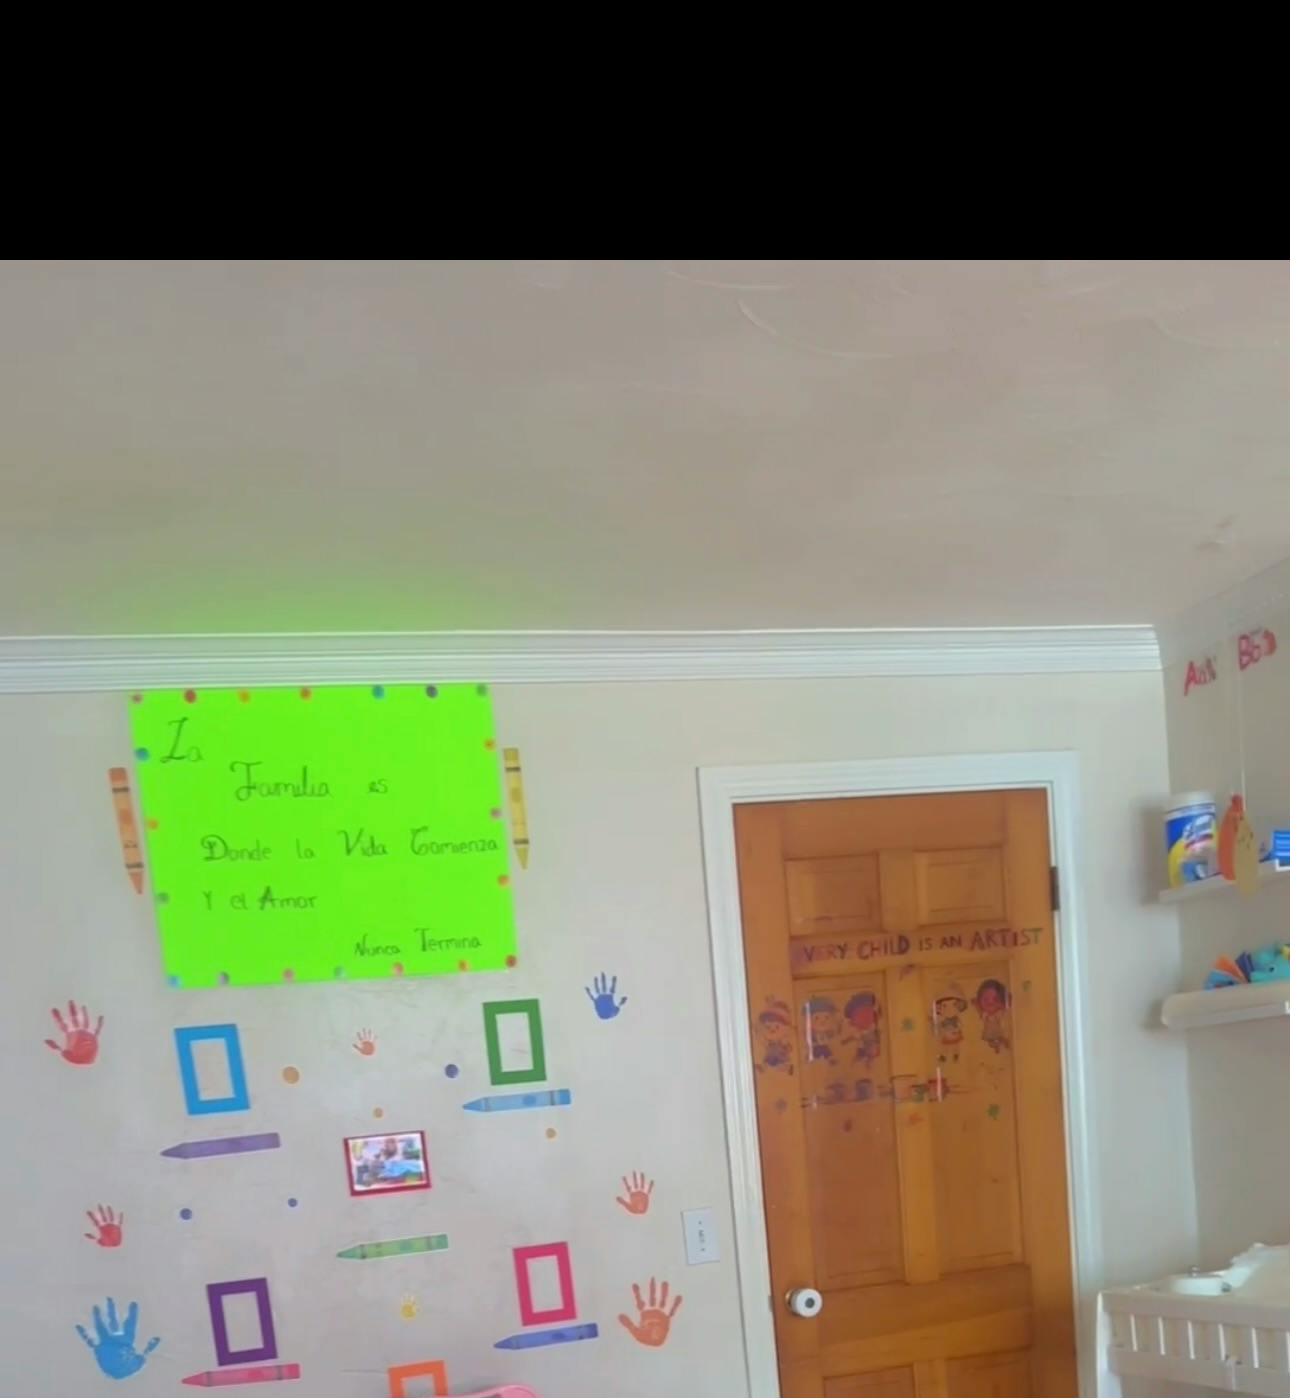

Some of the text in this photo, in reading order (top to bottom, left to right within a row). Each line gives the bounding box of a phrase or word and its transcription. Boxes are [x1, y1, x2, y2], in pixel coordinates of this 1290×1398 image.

[161, 717, 204, 763] La
[230, 761, 389, 801] Familia es
[201, 833, 273, 862] Donde
[296, 837, 316, 859] la
[338, 827, 388, 856] Vida
[230, 892, 249, 911] el
[258, 885, 318, 911] Amor
[354, 927, 483, 956] Nunca Termina
[857, 933, 910, 960] CHILD
[918, 936, 933, 952] IS
[939, 935, 962, 950] AN
[970, 927, 1043, 952] ARTIST
